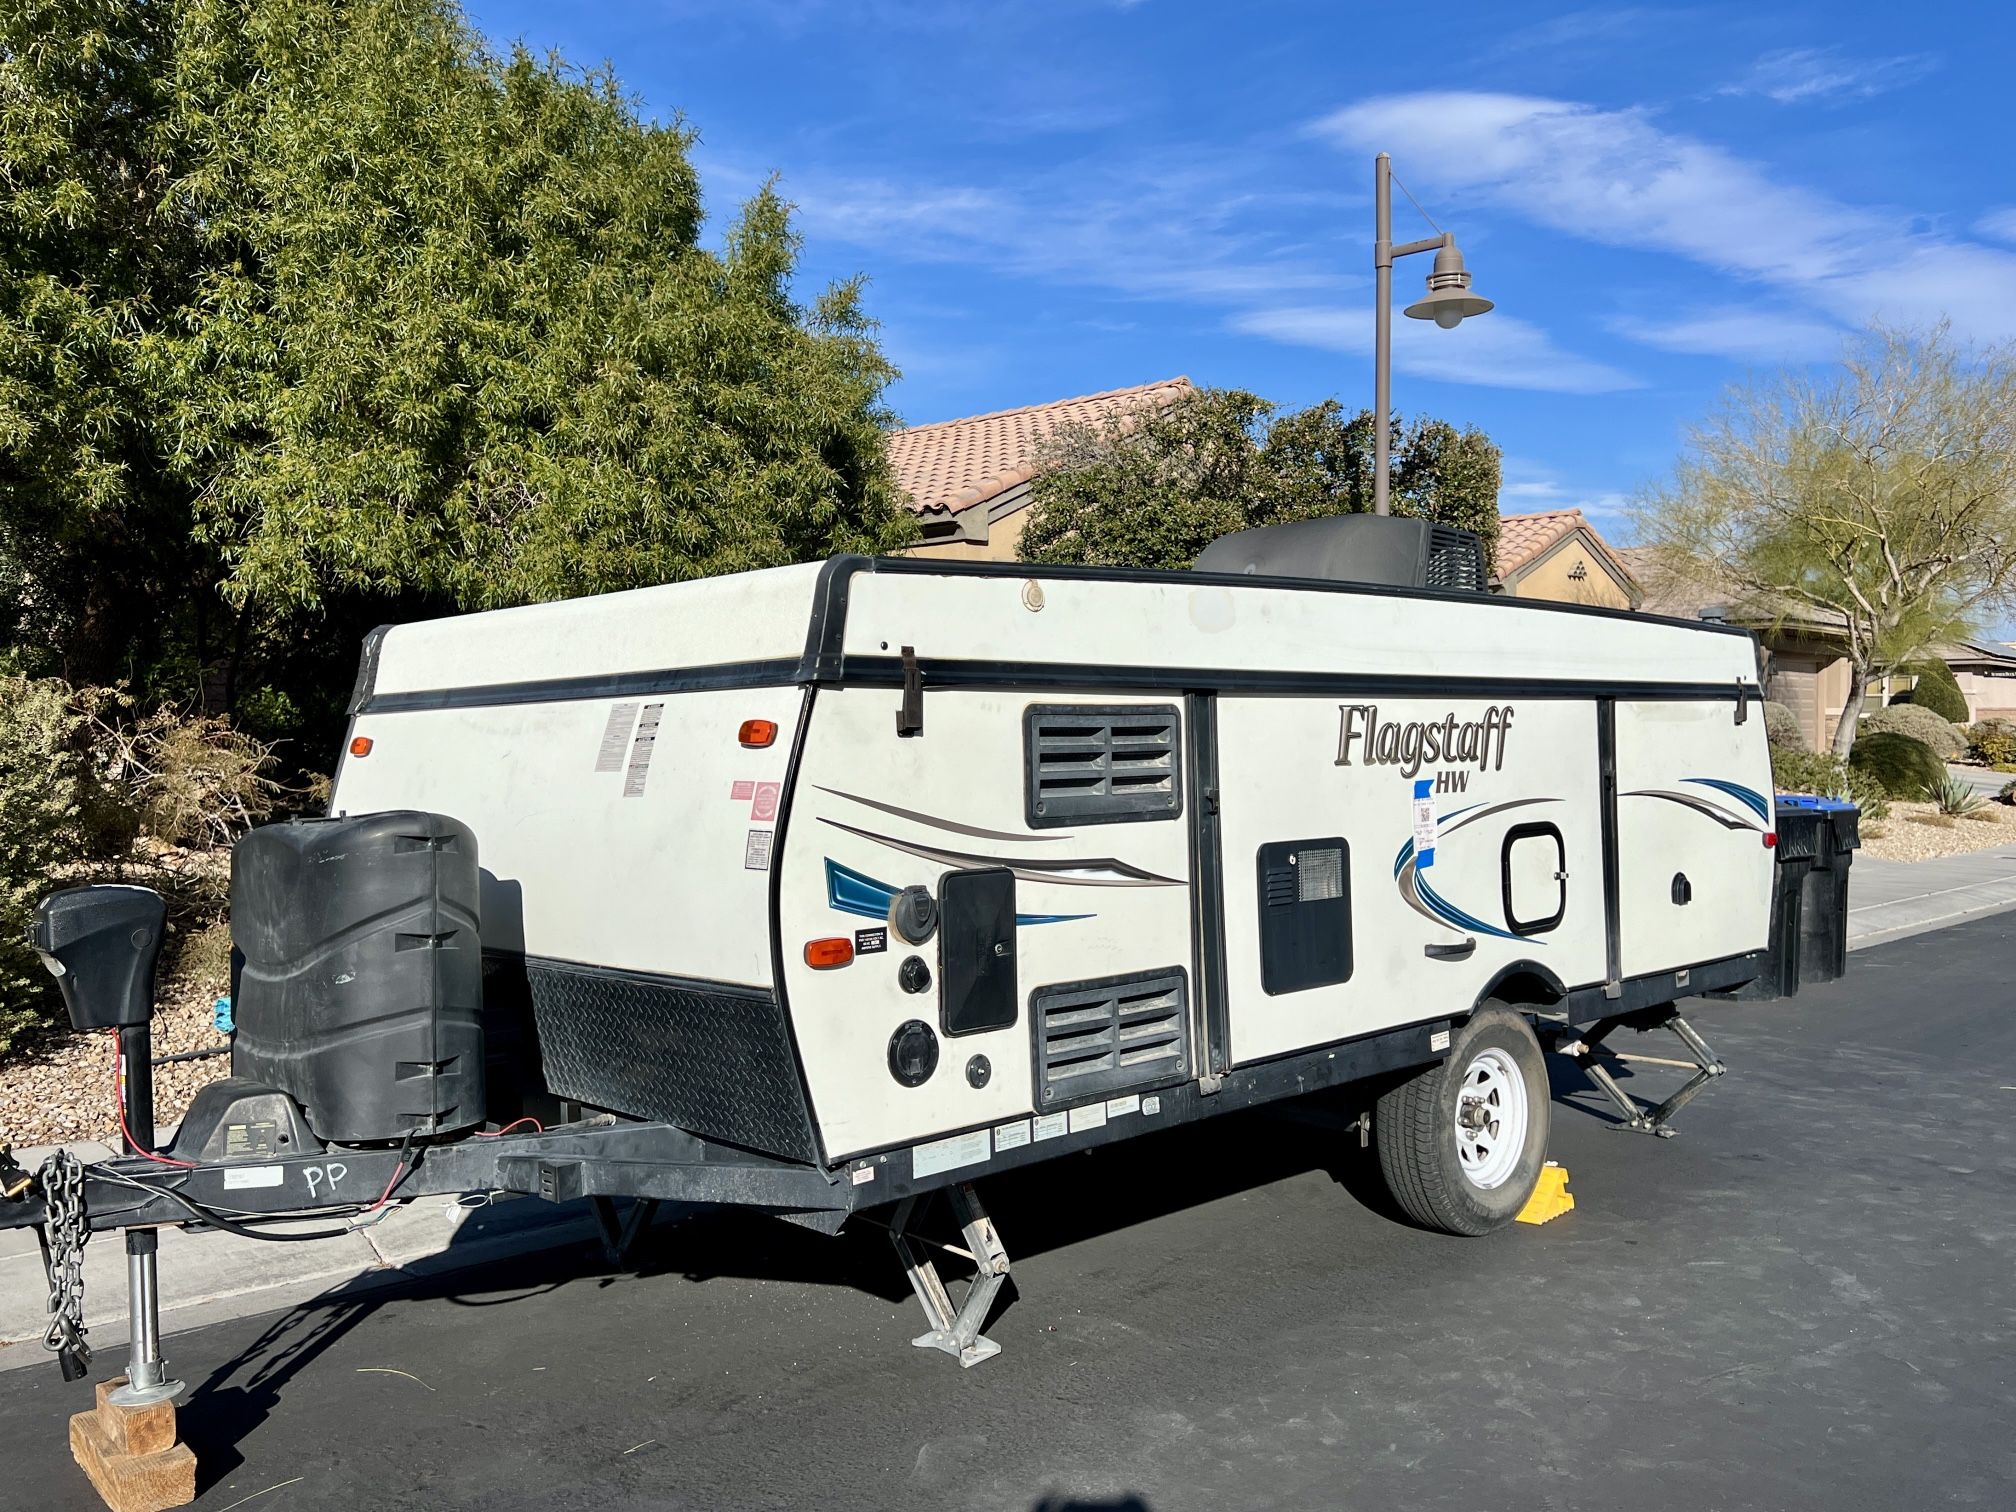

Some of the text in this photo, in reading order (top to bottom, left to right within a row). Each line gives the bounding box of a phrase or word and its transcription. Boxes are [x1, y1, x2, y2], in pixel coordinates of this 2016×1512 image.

[1334, 705, 1515, 779] Flagstaff
[1435, 770, 1470, 794] HW
[303, 1163, 348, 1199] PP
